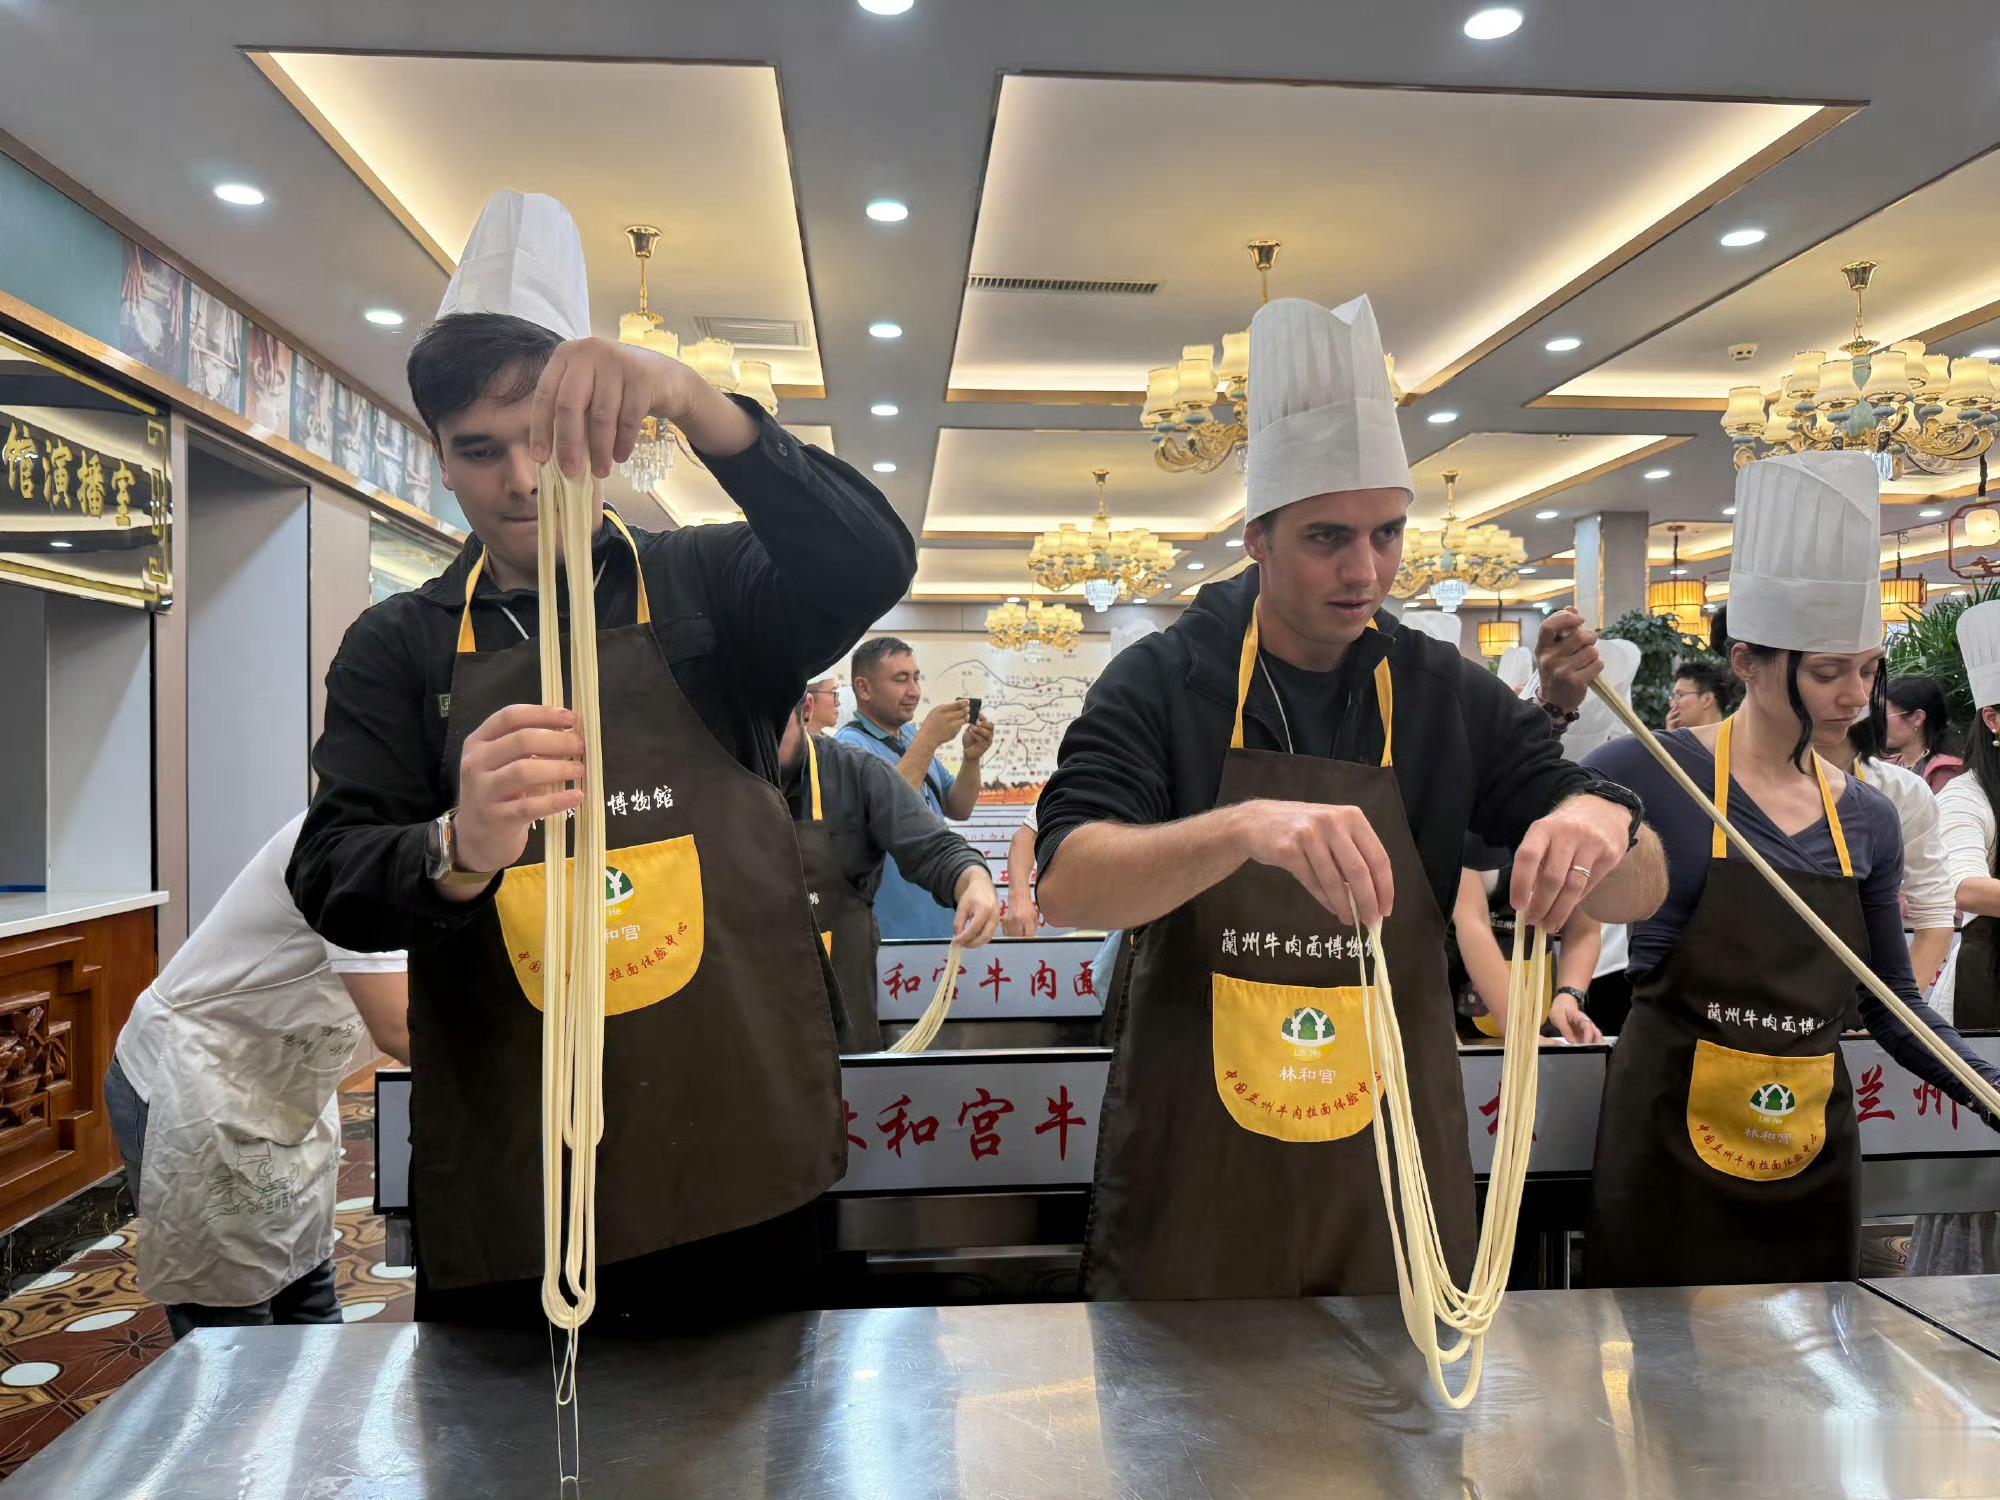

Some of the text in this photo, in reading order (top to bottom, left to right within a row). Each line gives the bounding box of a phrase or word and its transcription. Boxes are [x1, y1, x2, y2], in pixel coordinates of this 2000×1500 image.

[1707, 1002, 1826, 1036] 蘭州牛肉面博
